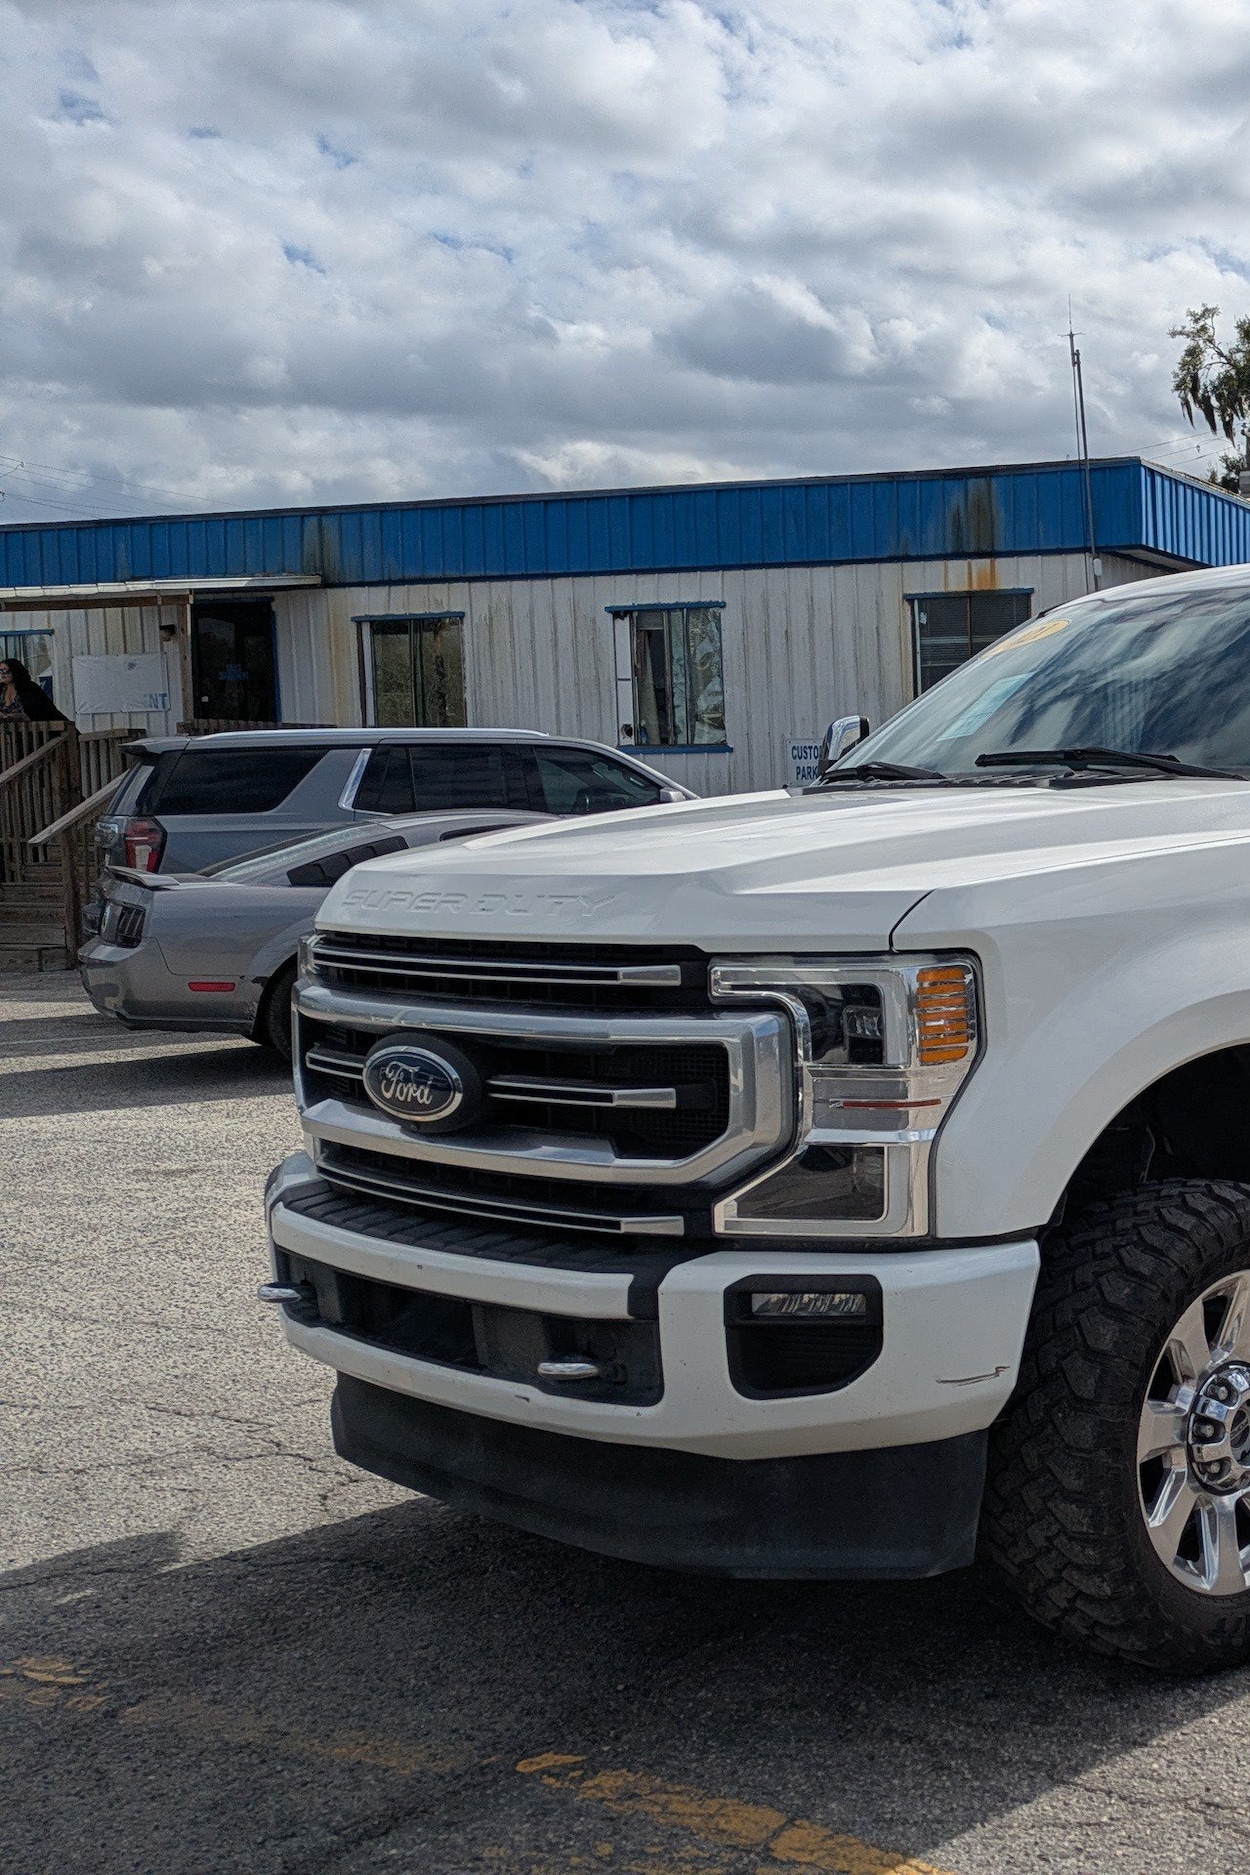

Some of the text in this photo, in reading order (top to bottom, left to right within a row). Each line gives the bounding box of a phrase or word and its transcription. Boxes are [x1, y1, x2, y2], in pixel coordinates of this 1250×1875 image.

[791, 745, 821, 760] CUSTO
[342, 889, 616, 917] SUPER DUTY
[381, 1061, 433, 1105] Ford
